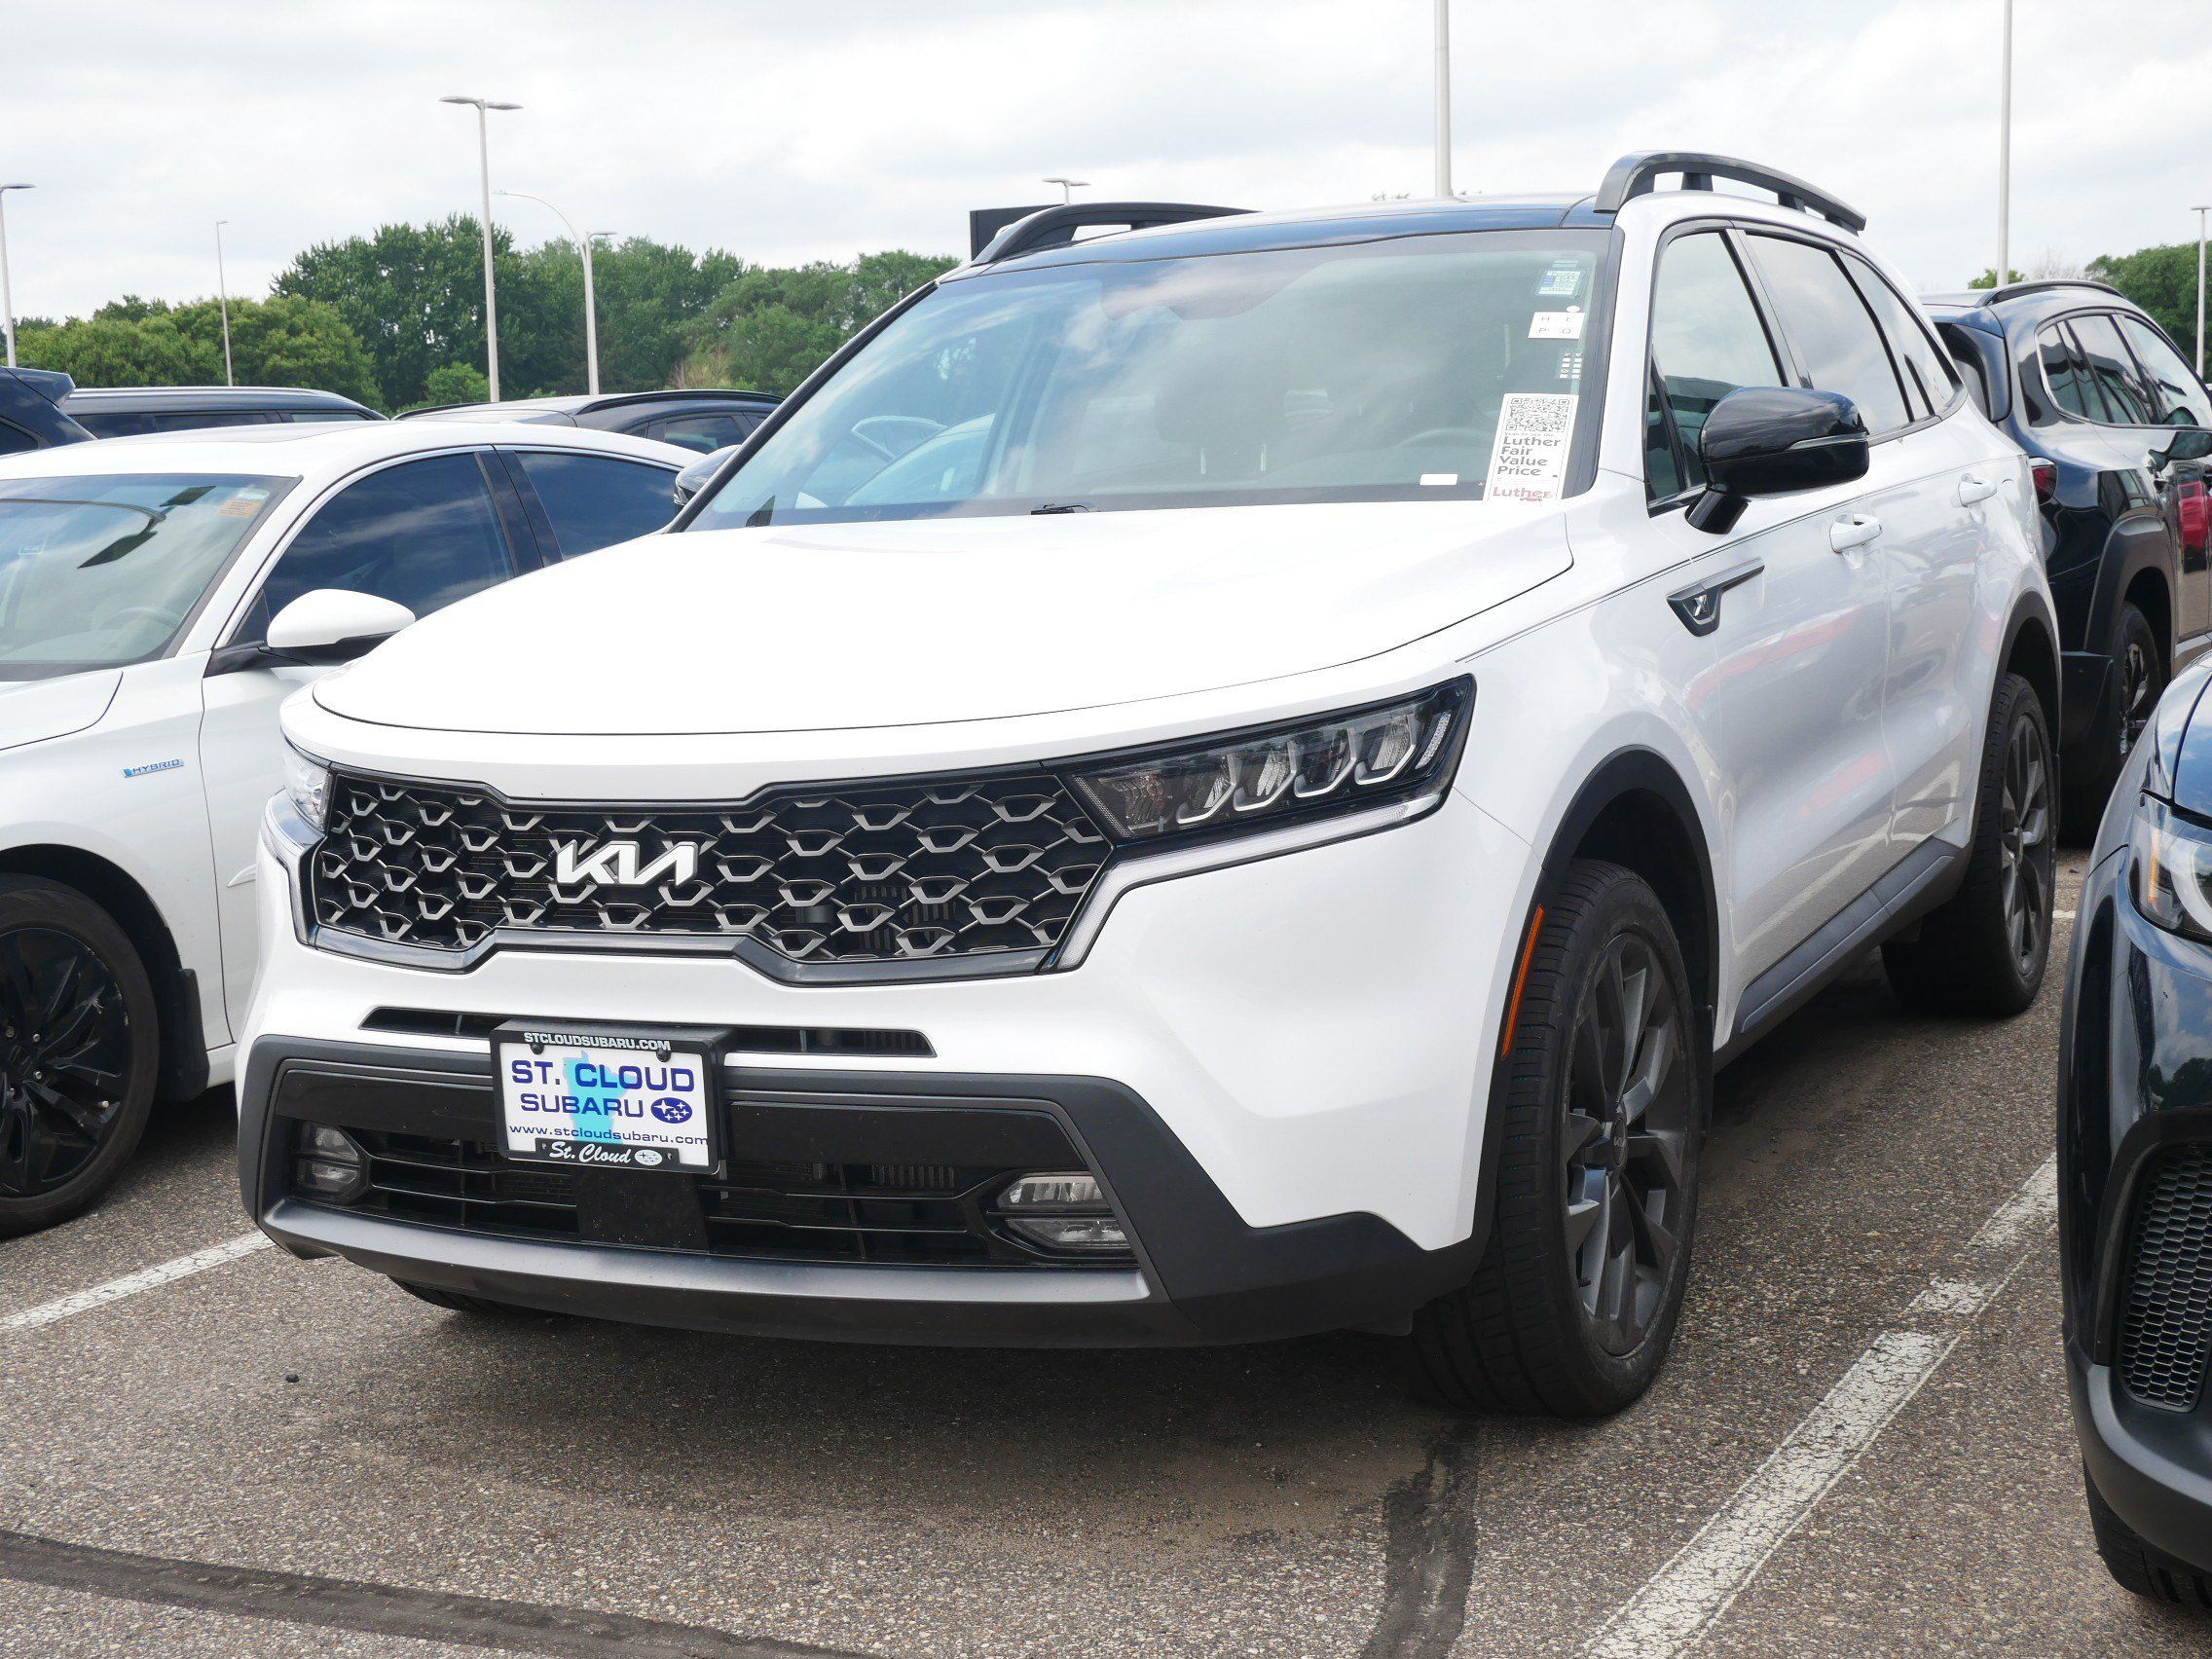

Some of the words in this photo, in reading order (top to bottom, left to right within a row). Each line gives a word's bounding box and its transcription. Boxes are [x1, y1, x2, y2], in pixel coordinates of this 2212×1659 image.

[1503, 435, 1562, 447] Luther
[1501, 446, 1533, 456] Fair
[1499, 456, 1548, 466] Value
[1496, 465, 1542, 476] Price
[1493, 486, 1552, 498] Luther
[132, 758, 180, 774] HYBRID
[557, 838, 699, 887] KIA
[523, 1031, 672, 1051] STCLOUDSUBARU.COM
[511, 1059, 561, 1086] ST.
[574, 1062, 695, 1092] CLOUD
[520, 1092, 645, 1119] SUBARU
[509, 1124, 709, 1147] www.stcloudsubaru.com
[549, 1141, 576, 1161] St.
[578, 1142, 632, 1163] Cloud
